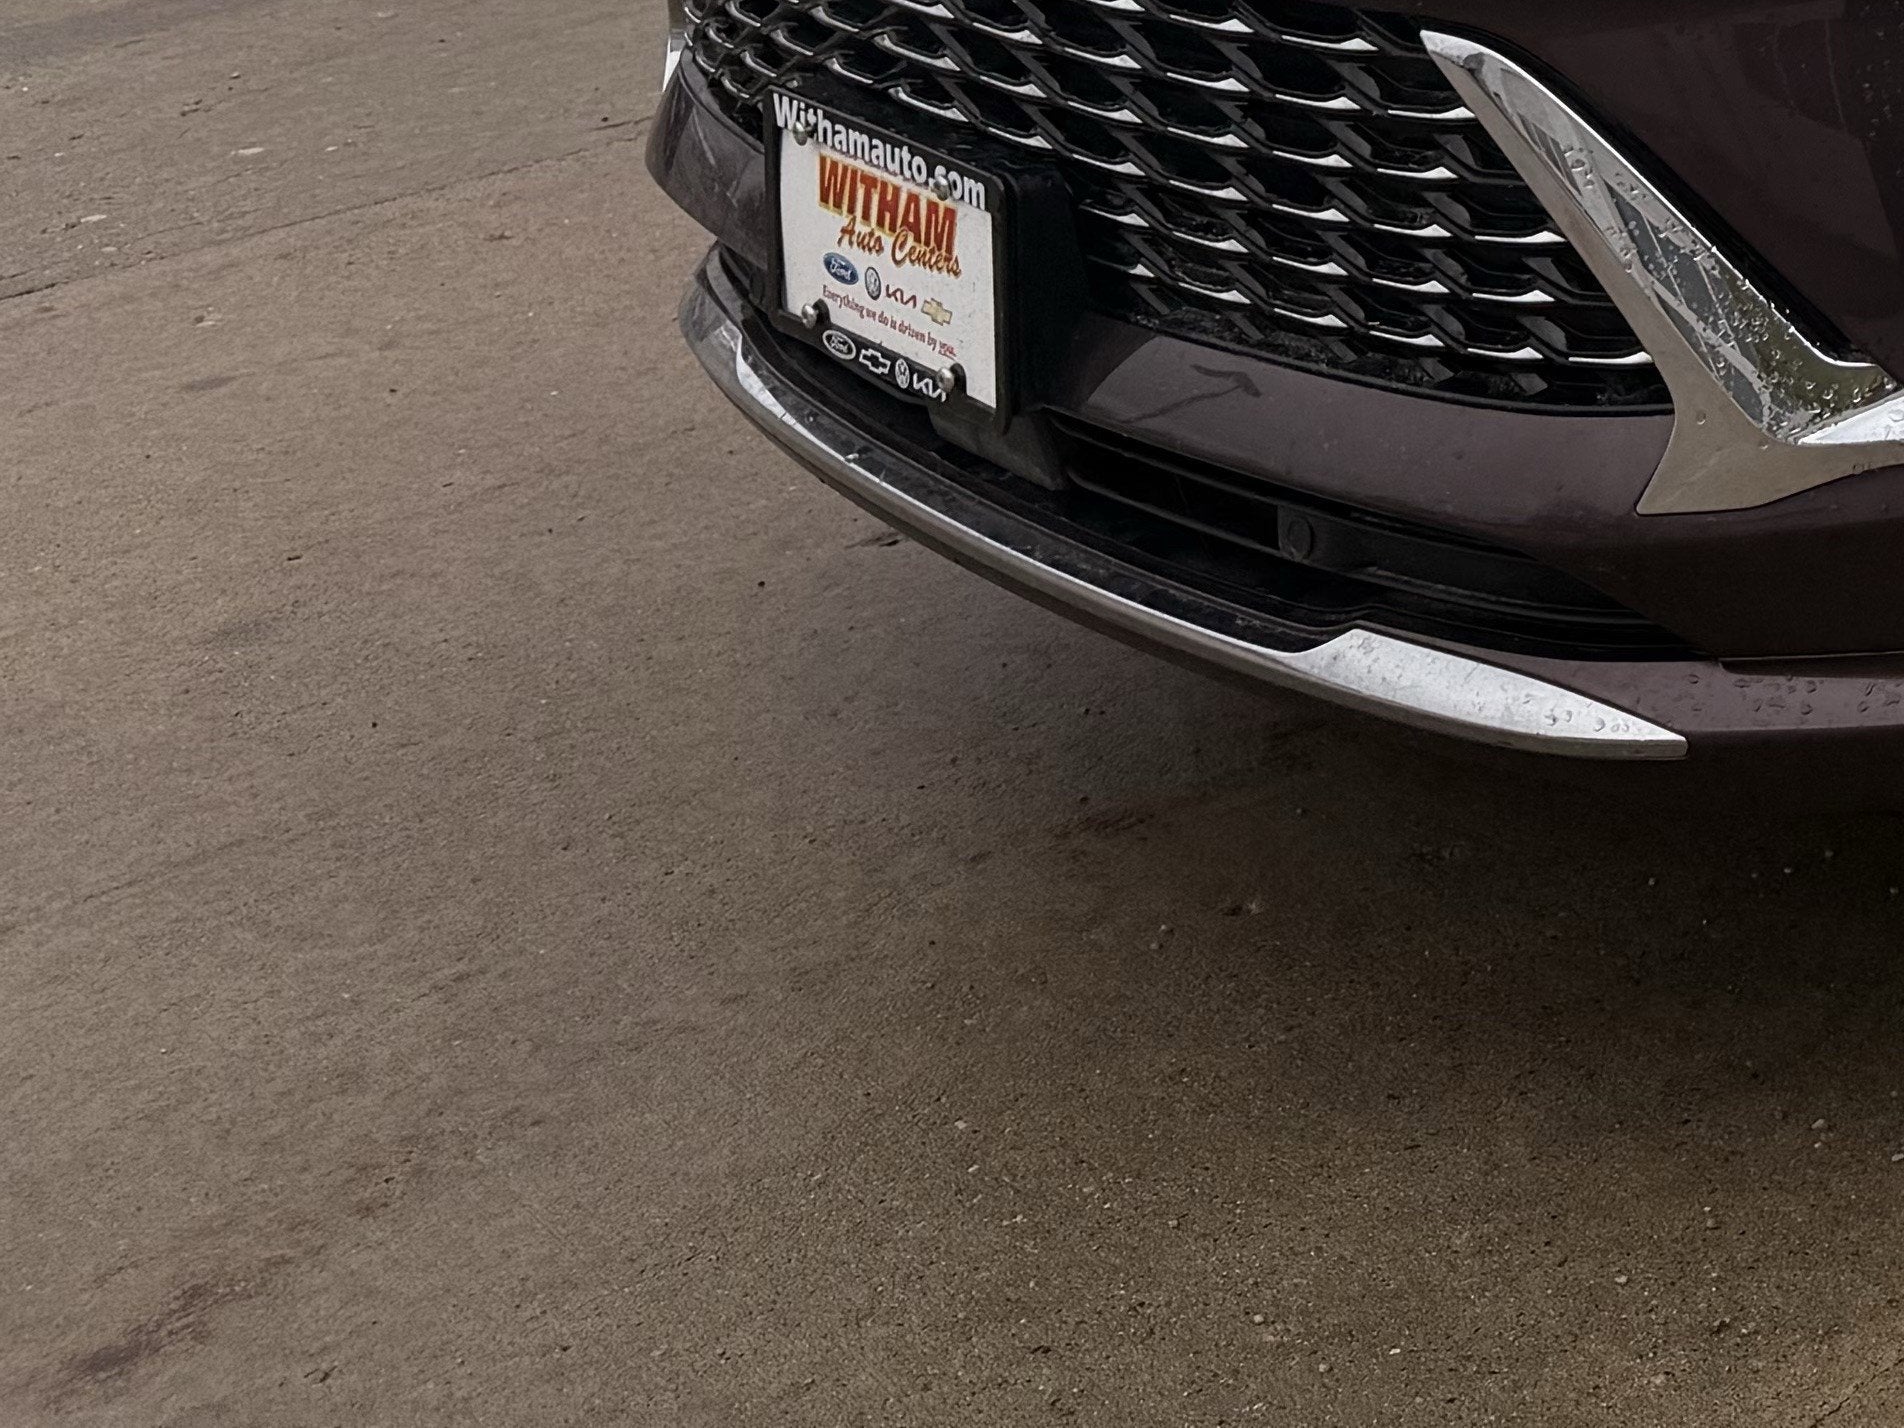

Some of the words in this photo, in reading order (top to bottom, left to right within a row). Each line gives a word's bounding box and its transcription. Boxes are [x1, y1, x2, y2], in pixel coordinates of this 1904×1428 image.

[818, 152, 958, 256] WITHAM
[836, 215, 885, 257] Auto
[891, 228, 962, 279] Centers
